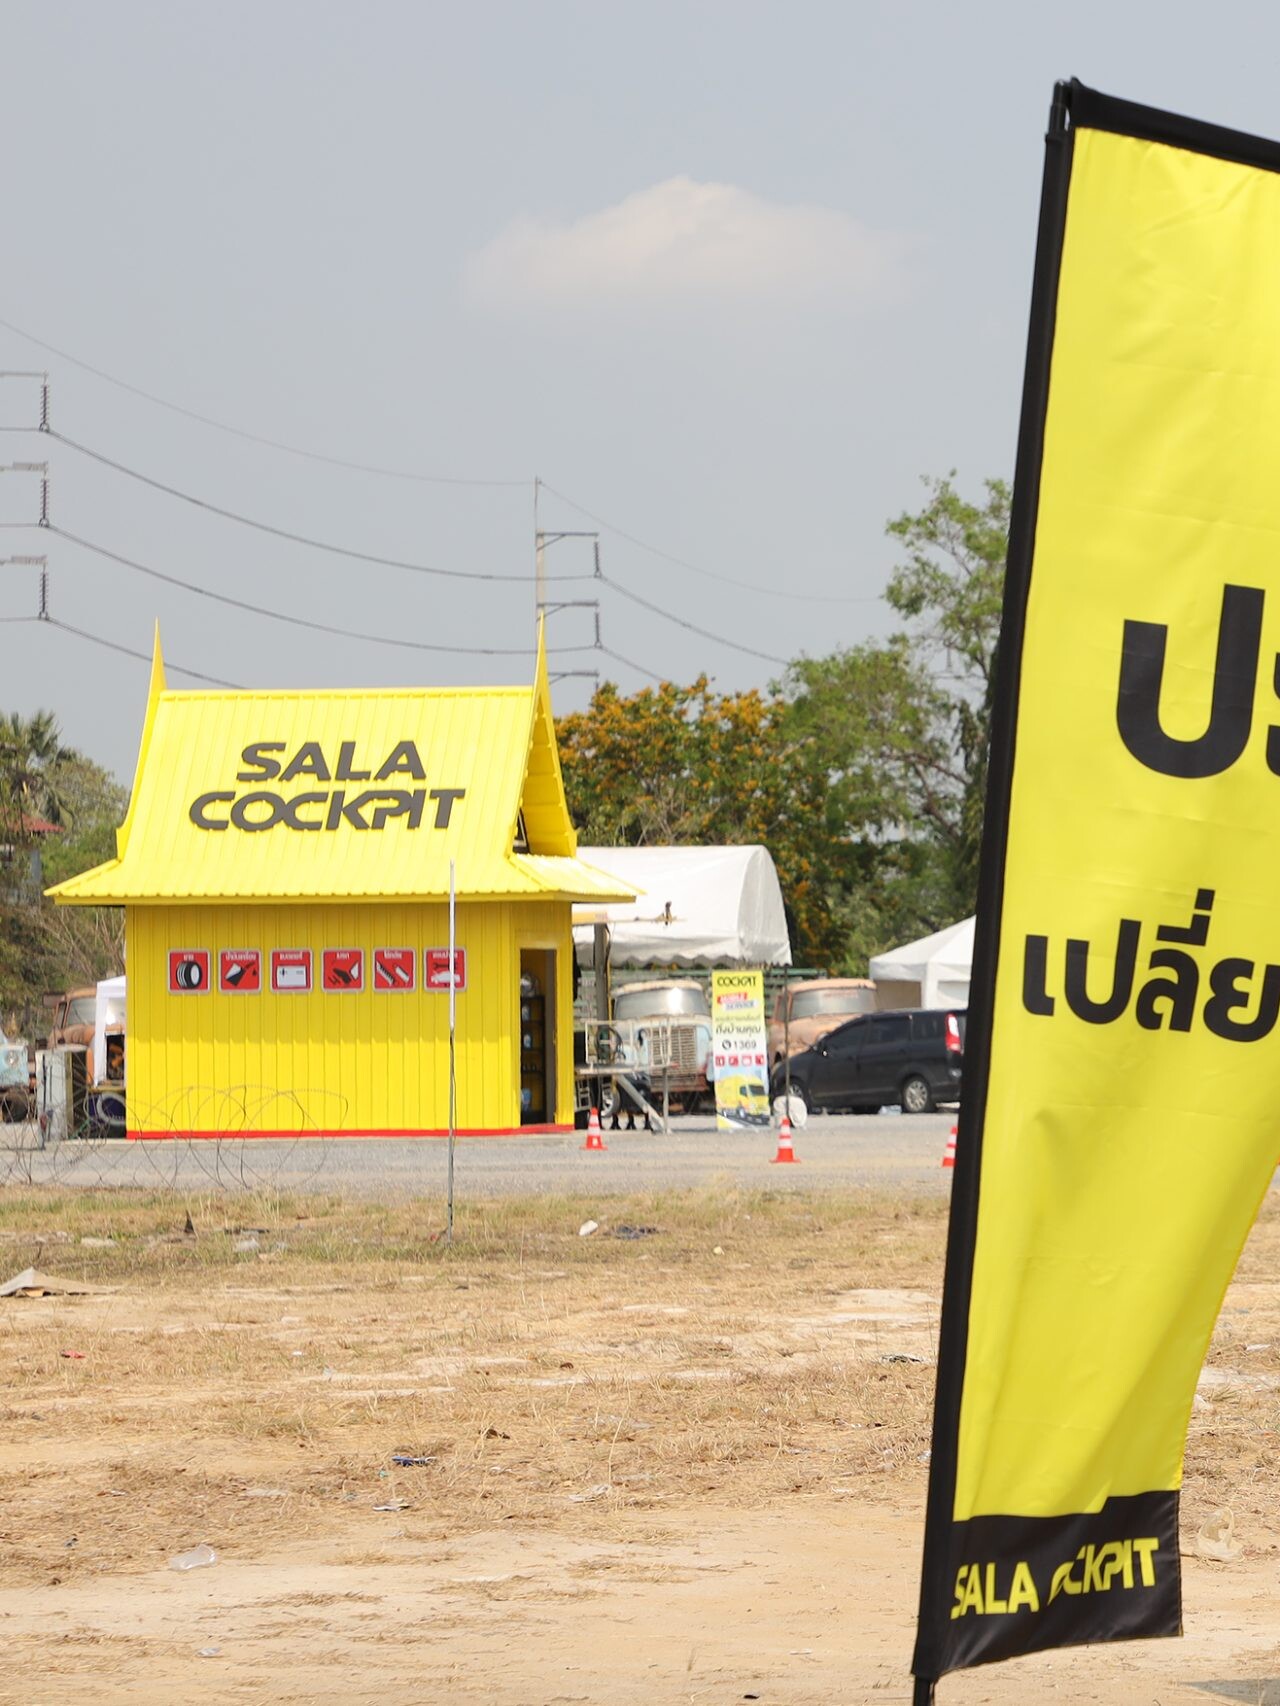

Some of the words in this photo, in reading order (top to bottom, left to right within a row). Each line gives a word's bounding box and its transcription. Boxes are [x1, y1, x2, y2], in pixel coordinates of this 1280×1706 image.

[236, 740, 426, 782] SALA
[189, 788, 465, 832] COCKPIT
[950, 1561, 1040, 1620] SALA
